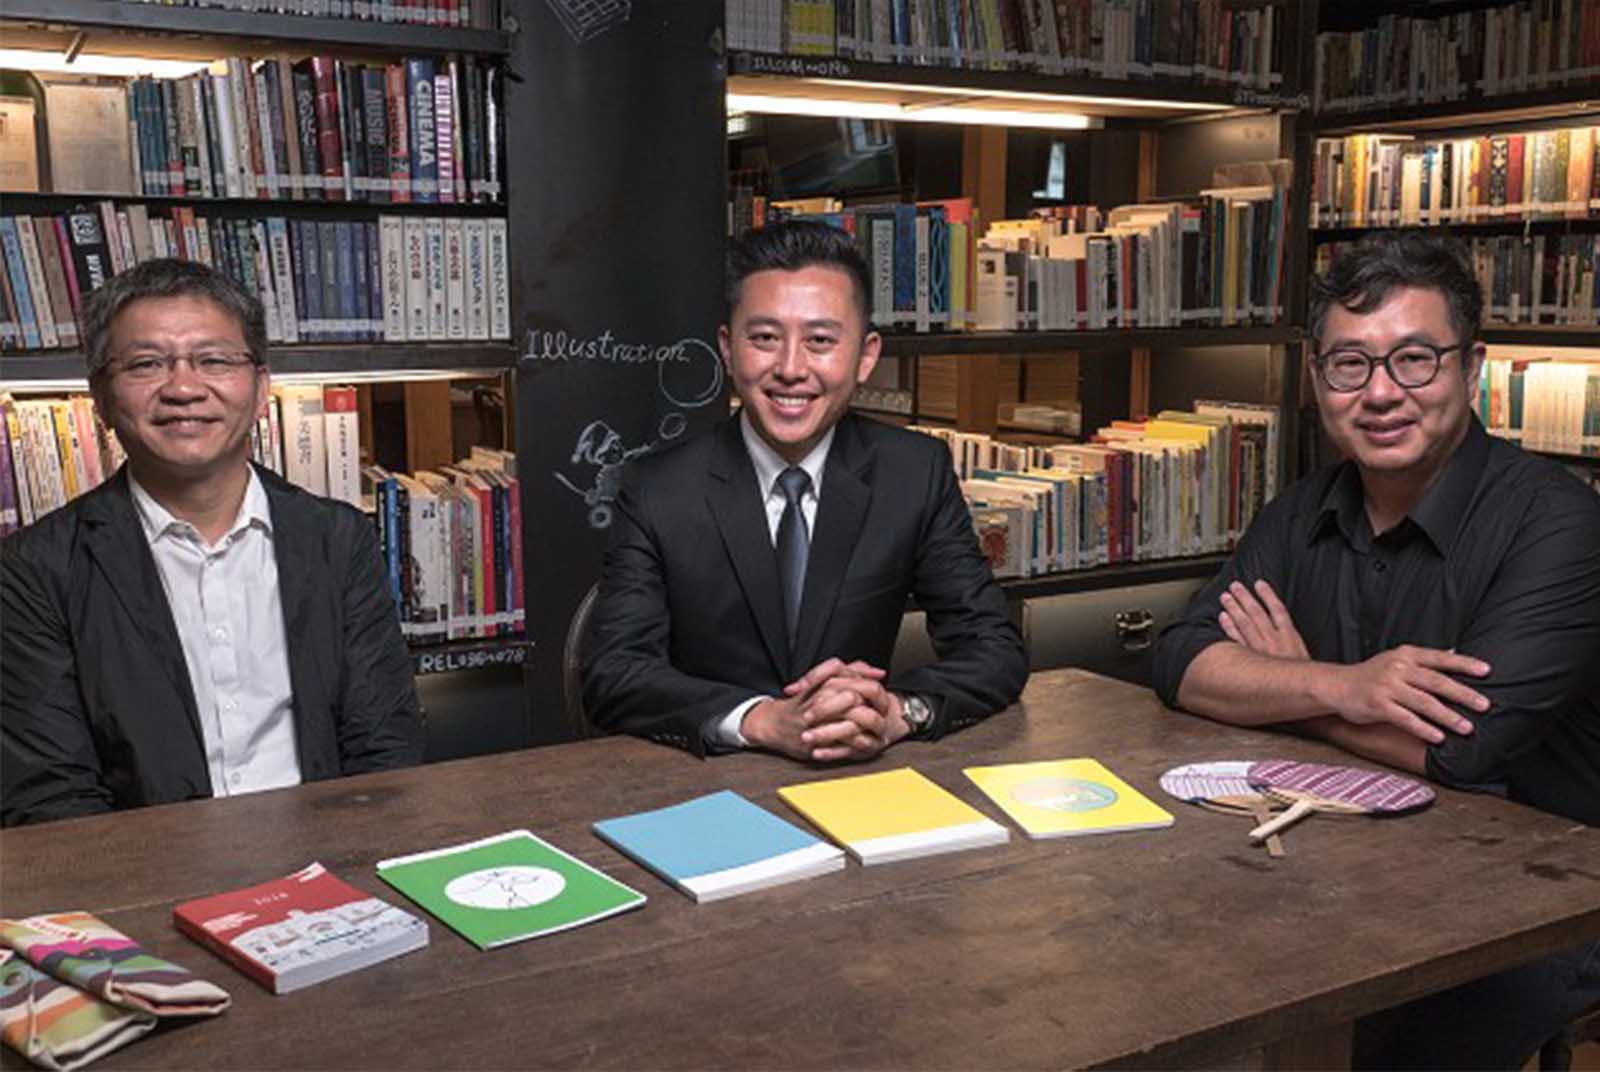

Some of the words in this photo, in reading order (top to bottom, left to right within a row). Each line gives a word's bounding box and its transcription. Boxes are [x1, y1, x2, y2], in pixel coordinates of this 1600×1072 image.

[365, 88, 386, 146] MUSIC
[415, 80, 435, 167] CINEMA
[521, 328, 691, 364] Illustration
